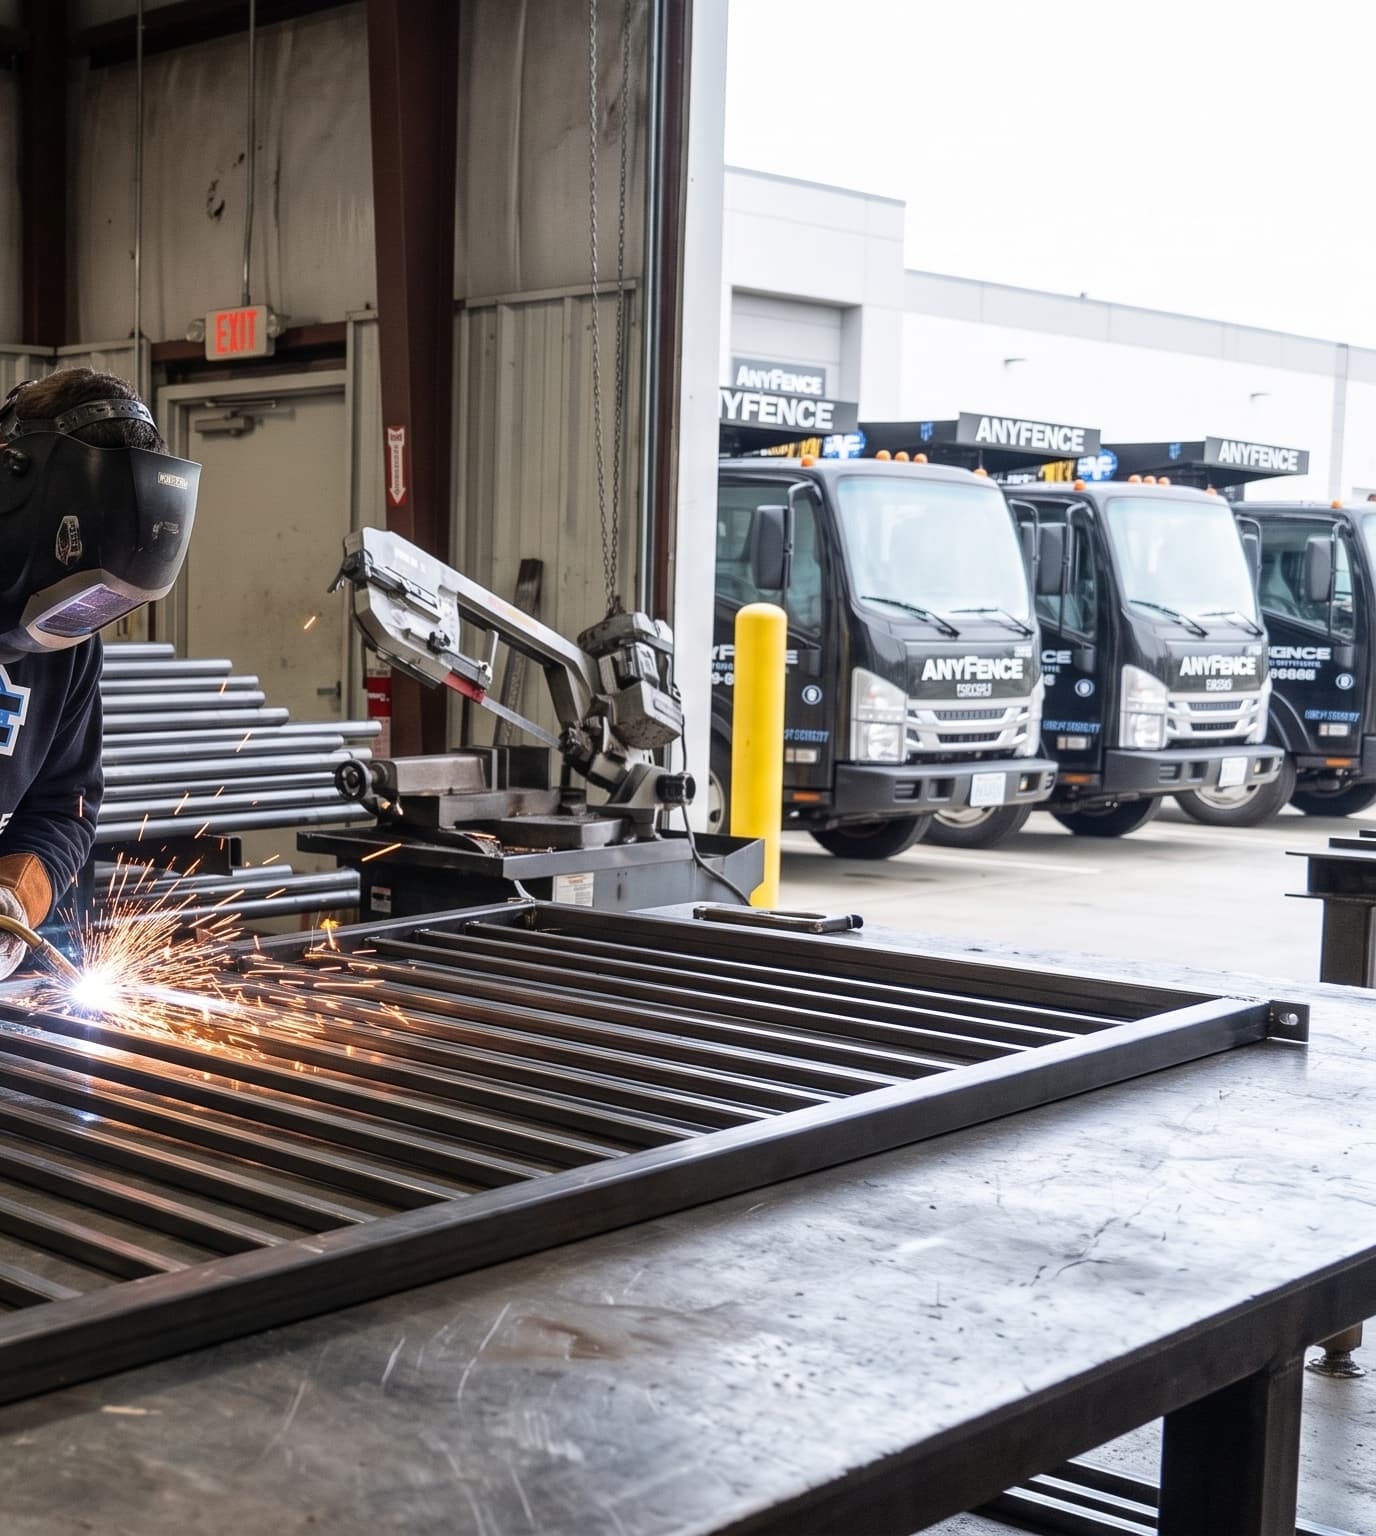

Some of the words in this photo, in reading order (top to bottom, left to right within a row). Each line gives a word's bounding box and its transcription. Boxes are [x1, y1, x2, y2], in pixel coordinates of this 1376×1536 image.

[215, 309, 258, 354] EXIT
[720, 390, 835, 430] YFENCE
[975, 417, 1086, 452] ANYFENCE
[1218, 441, 1299, 471] ANYFENCE
